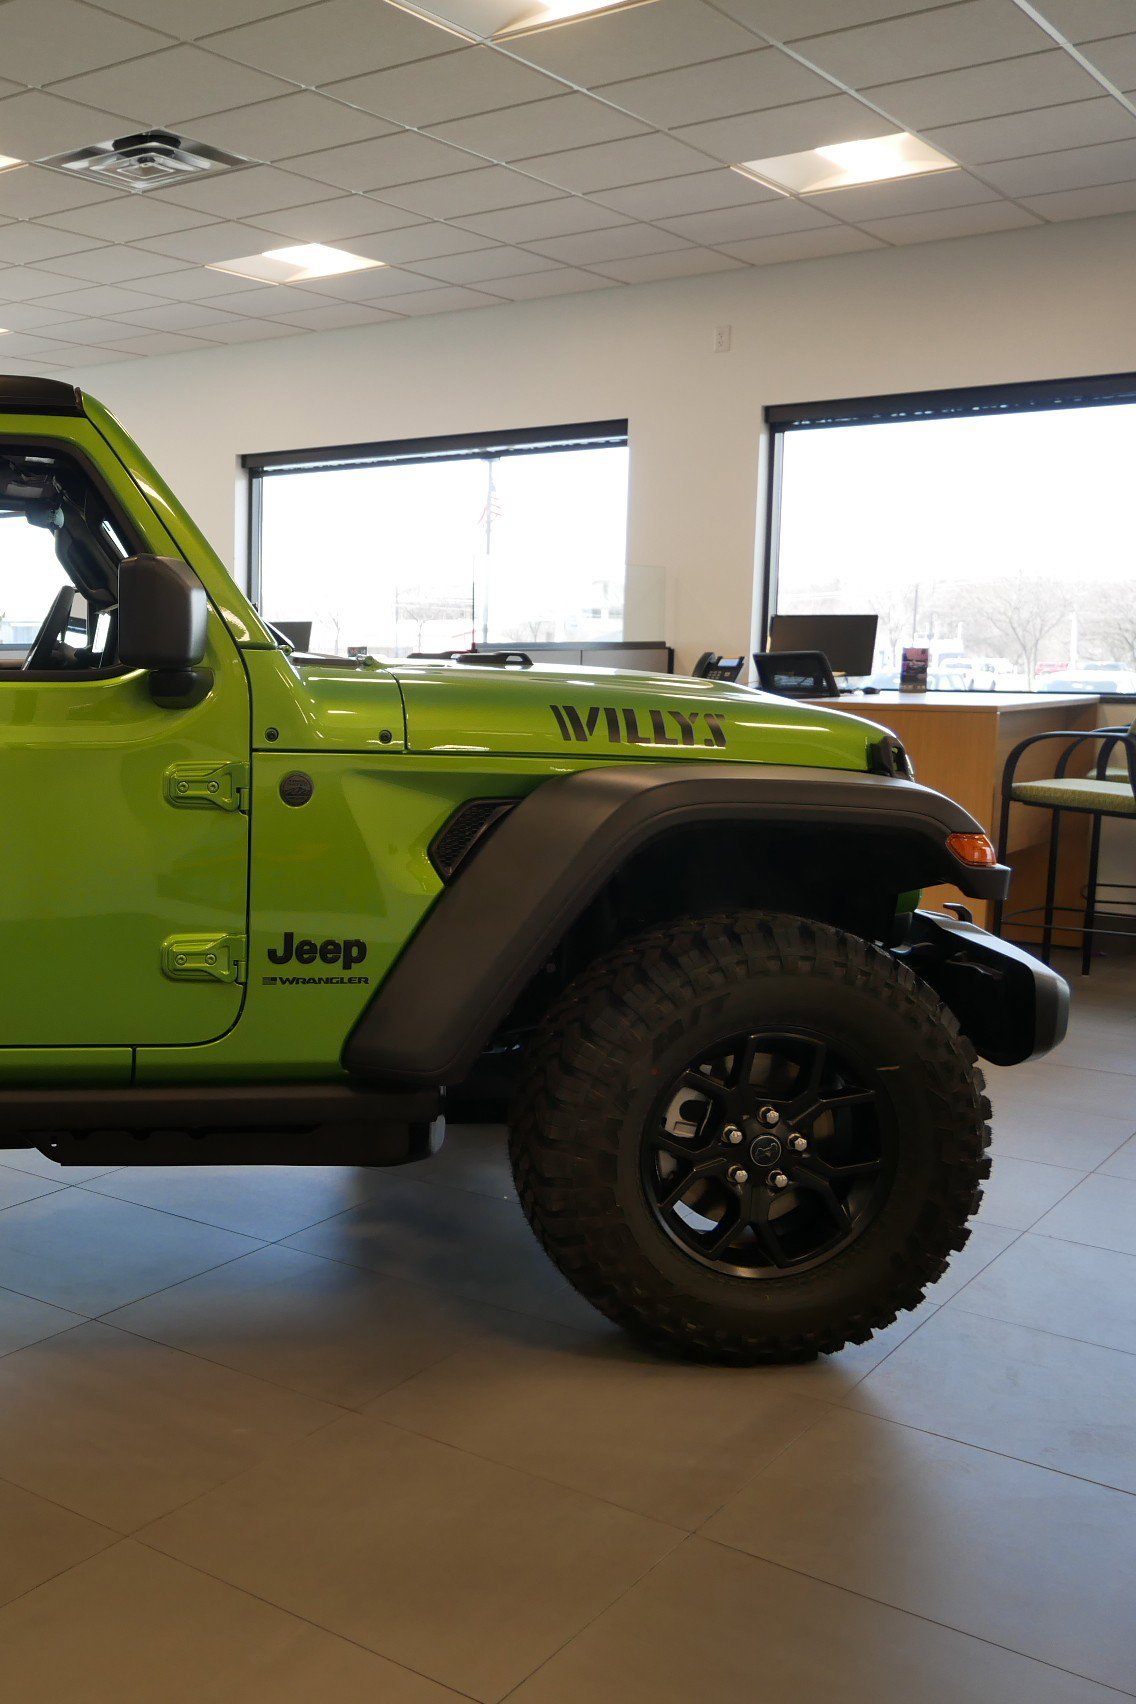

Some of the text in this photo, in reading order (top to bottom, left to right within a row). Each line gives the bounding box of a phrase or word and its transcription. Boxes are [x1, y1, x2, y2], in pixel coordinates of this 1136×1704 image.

[549, 704, 727, 747] WILLYS
[267, 931, 367, 970] Jeep
[279, 976, 370, 985] WRANGLER
